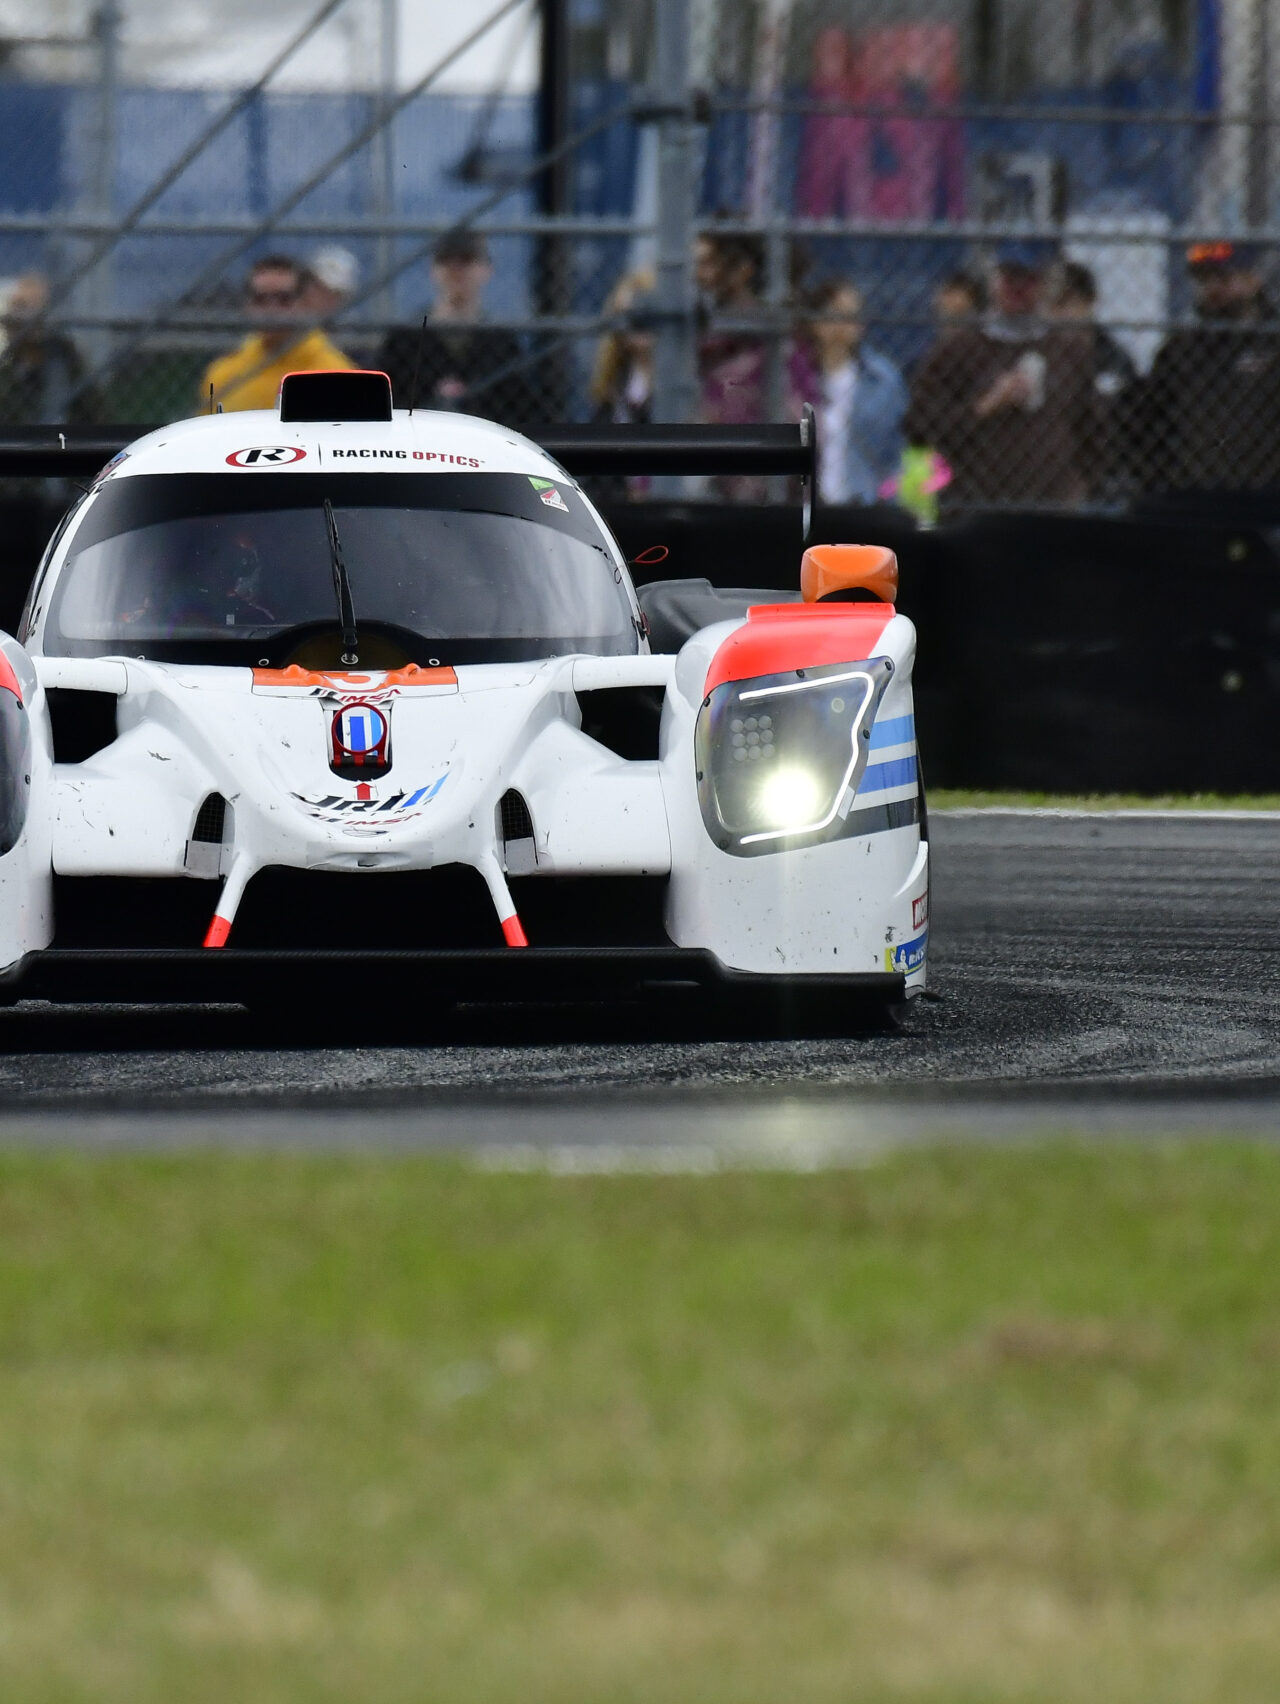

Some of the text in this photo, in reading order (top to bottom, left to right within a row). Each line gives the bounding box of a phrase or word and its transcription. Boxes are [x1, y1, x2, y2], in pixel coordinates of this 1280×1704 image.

[245, 448, 286, 464] R
[332, 449, 480, 468] RACING OPTICS
[339, 688, 402, 703] IMSA
